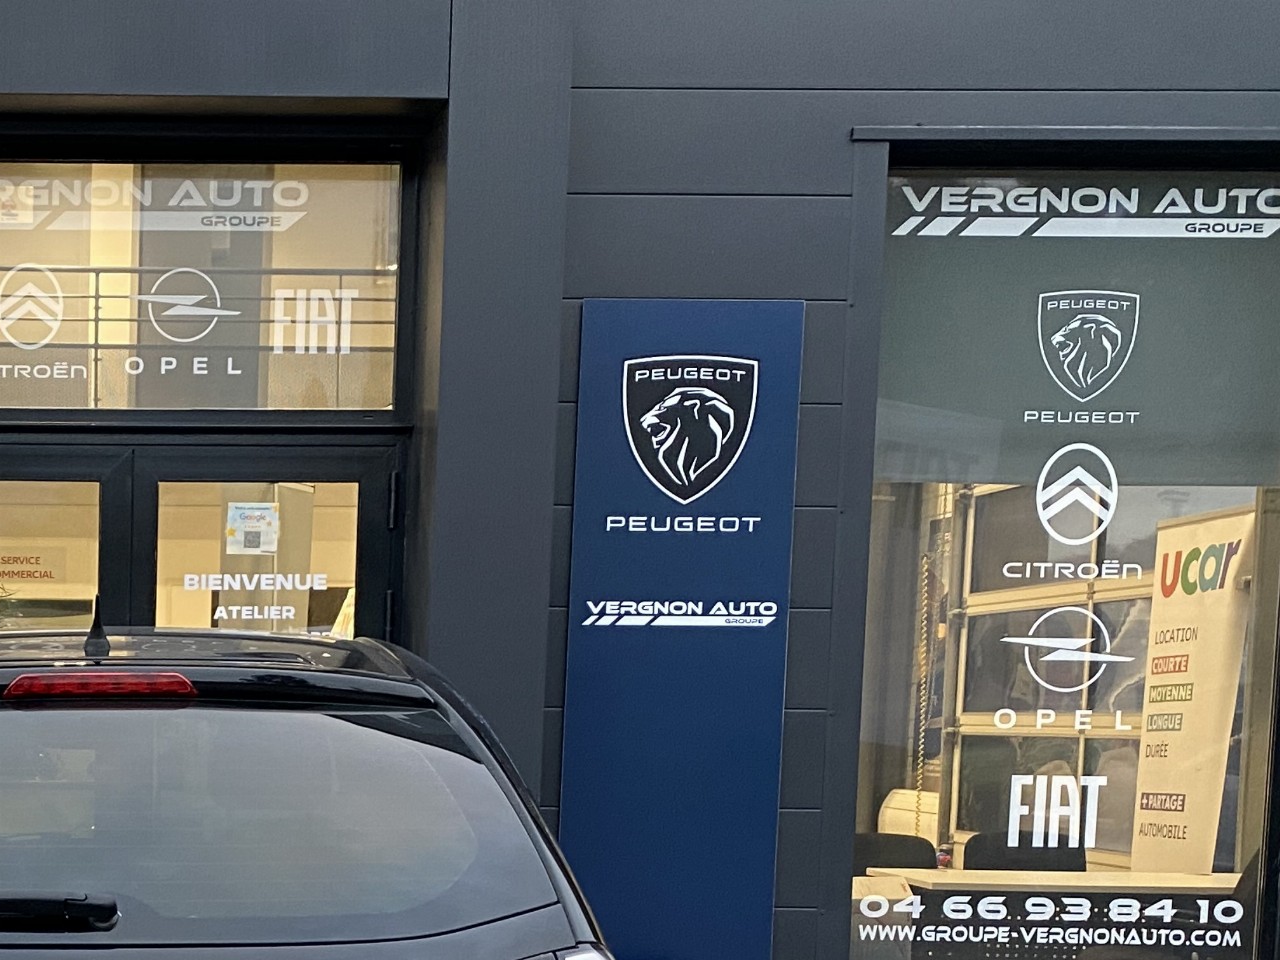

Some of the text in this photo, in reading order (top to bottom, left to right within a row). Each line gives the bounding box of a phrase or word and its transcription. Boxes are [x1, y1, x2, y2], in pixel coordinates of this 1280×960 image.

[167, 180, 310, 208] AUTO
[902, 186, 1280, 216] VERGNON AUTO
[200, 215, 282, 227] GROUPE
[1184, 222, 1265, 233] GROUPE
[1047, 299, 1131, 311] PEUGEOT
[271, 289, 359, 355] FIAT
[125, 356, 242, 376] OPEL
[635, 368, 746, 382] PEUGEOT
[1024, 411, 1140, 424] PEUGEOT
[606, 516, 761, 532] PEUGEOT
[1, 556, 41, 565] SERVICE
[1160, 538, 1242, 599] ucar
[1002, 560, 1142, 580] CITROËN
[184, 574, 327, 590] BIENVENUE
[214, 606, 294, 619] ATELIER
[586, 601, 777, 615] VERGNON AUTO
[1155, 626, 1199, 645] LOCATION
[1152, 656, 1187, 673] COURTE
[1149, 684, 1192, 701] MOYENNE
[994, 708, 1132, 730] OPEL
[1147, 714, 1181, 730] LONGUE
[1145, 742, 1169, 759] DURÉE
[1007, 774, 1108, 848] FIAT
[1139, 822, 1187, 840] AUTOMOBILE
[859, 895, 1244, 924] 04 66 93 84 10
[858, 925, 1242, 947] WWW.GROUPE-VERGNONAUTO.COM
